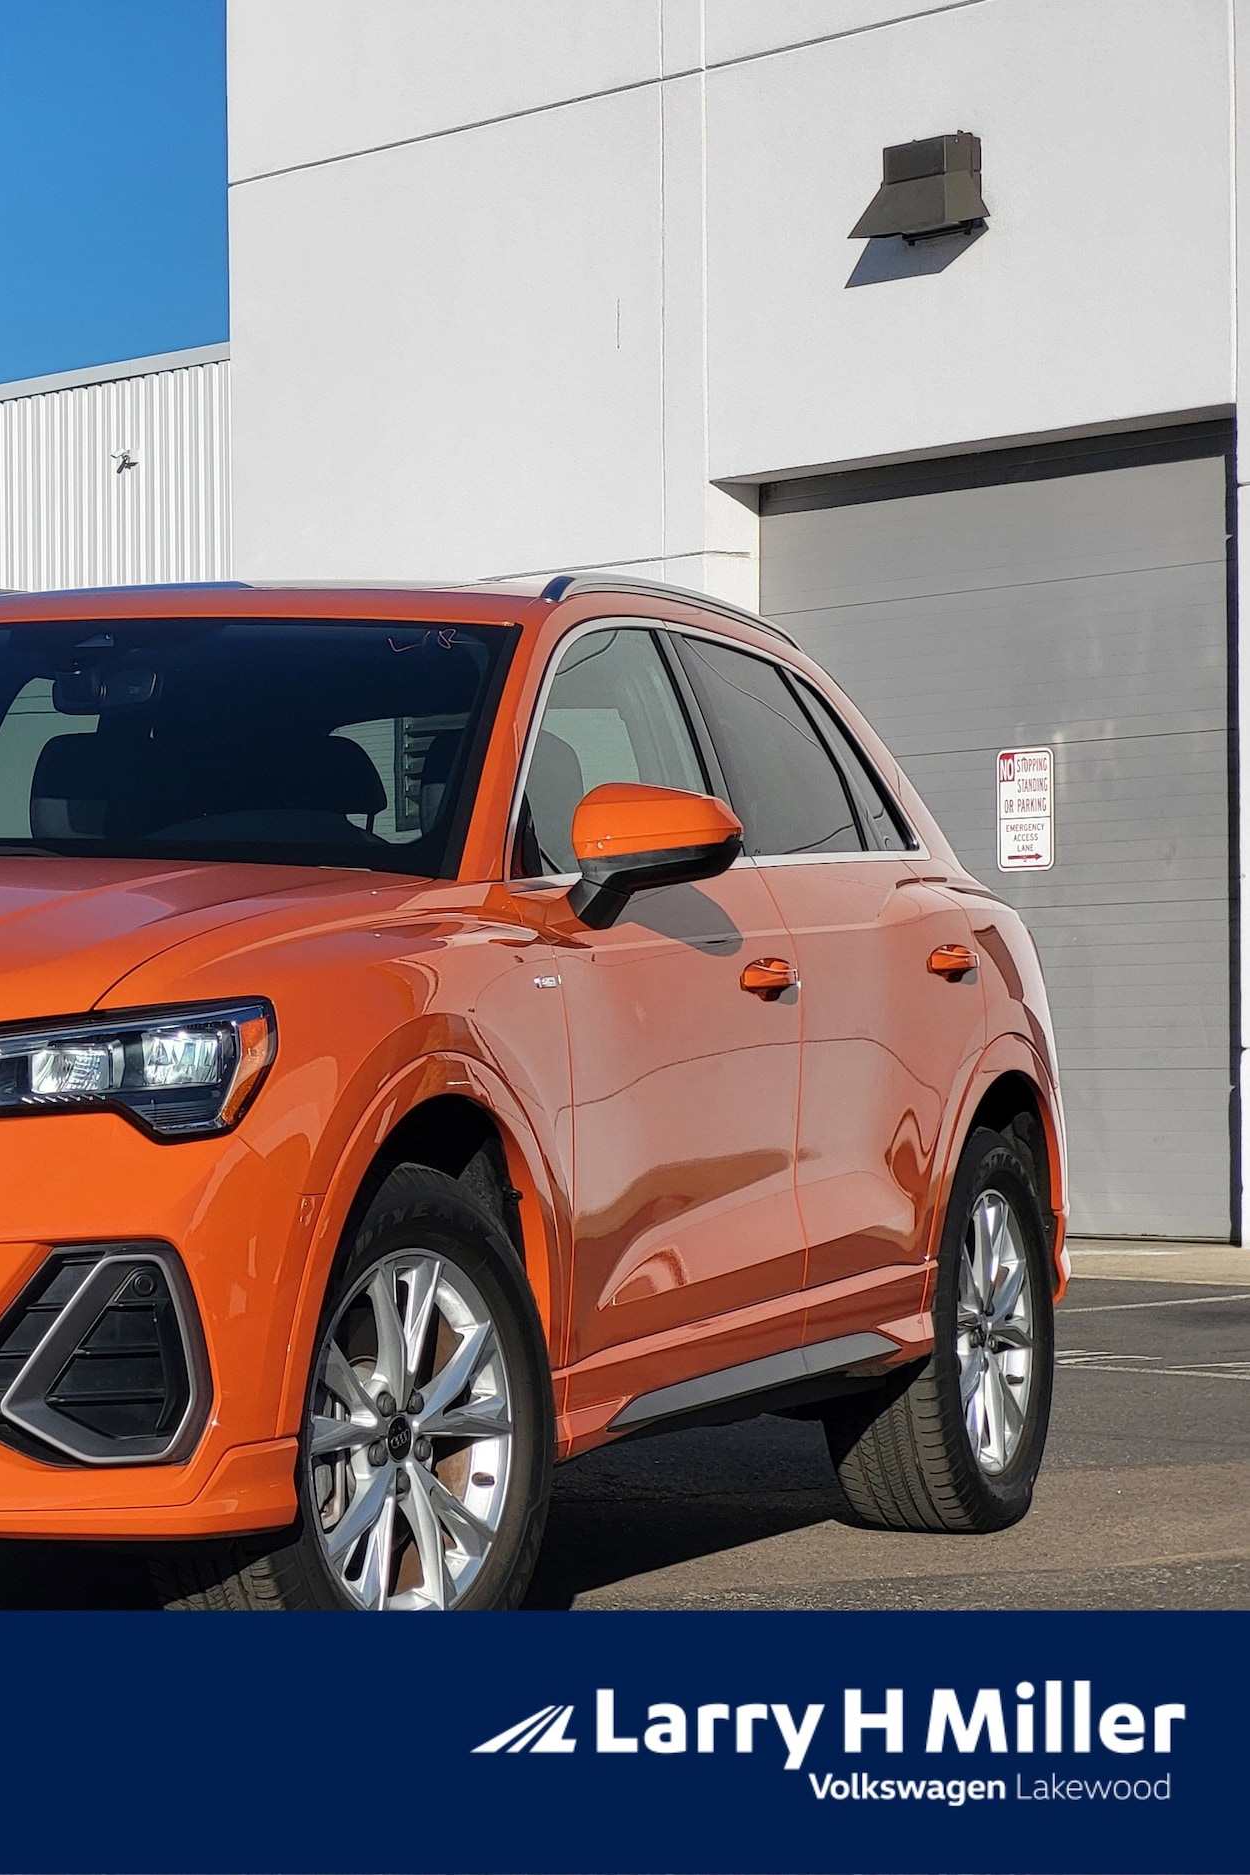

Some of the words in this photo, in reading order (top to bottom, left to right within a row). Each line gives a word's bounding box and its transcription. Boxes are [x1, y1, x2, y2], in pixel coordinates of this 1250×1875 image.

[1000, 758, 1014, 781] NO
[1016, 757, 1047, 773] STOPPING
[1017, 777, 1048, 793] STANDING
[1004, 799, 1014, 814] OR
[1017, 797, 1047, 813] PARKING
[1005, 823, 1045, 832] EMERGENCY
[1013, 833, 1039, 842] ACCESS
[1017, 844, 1034, 852] LANE
